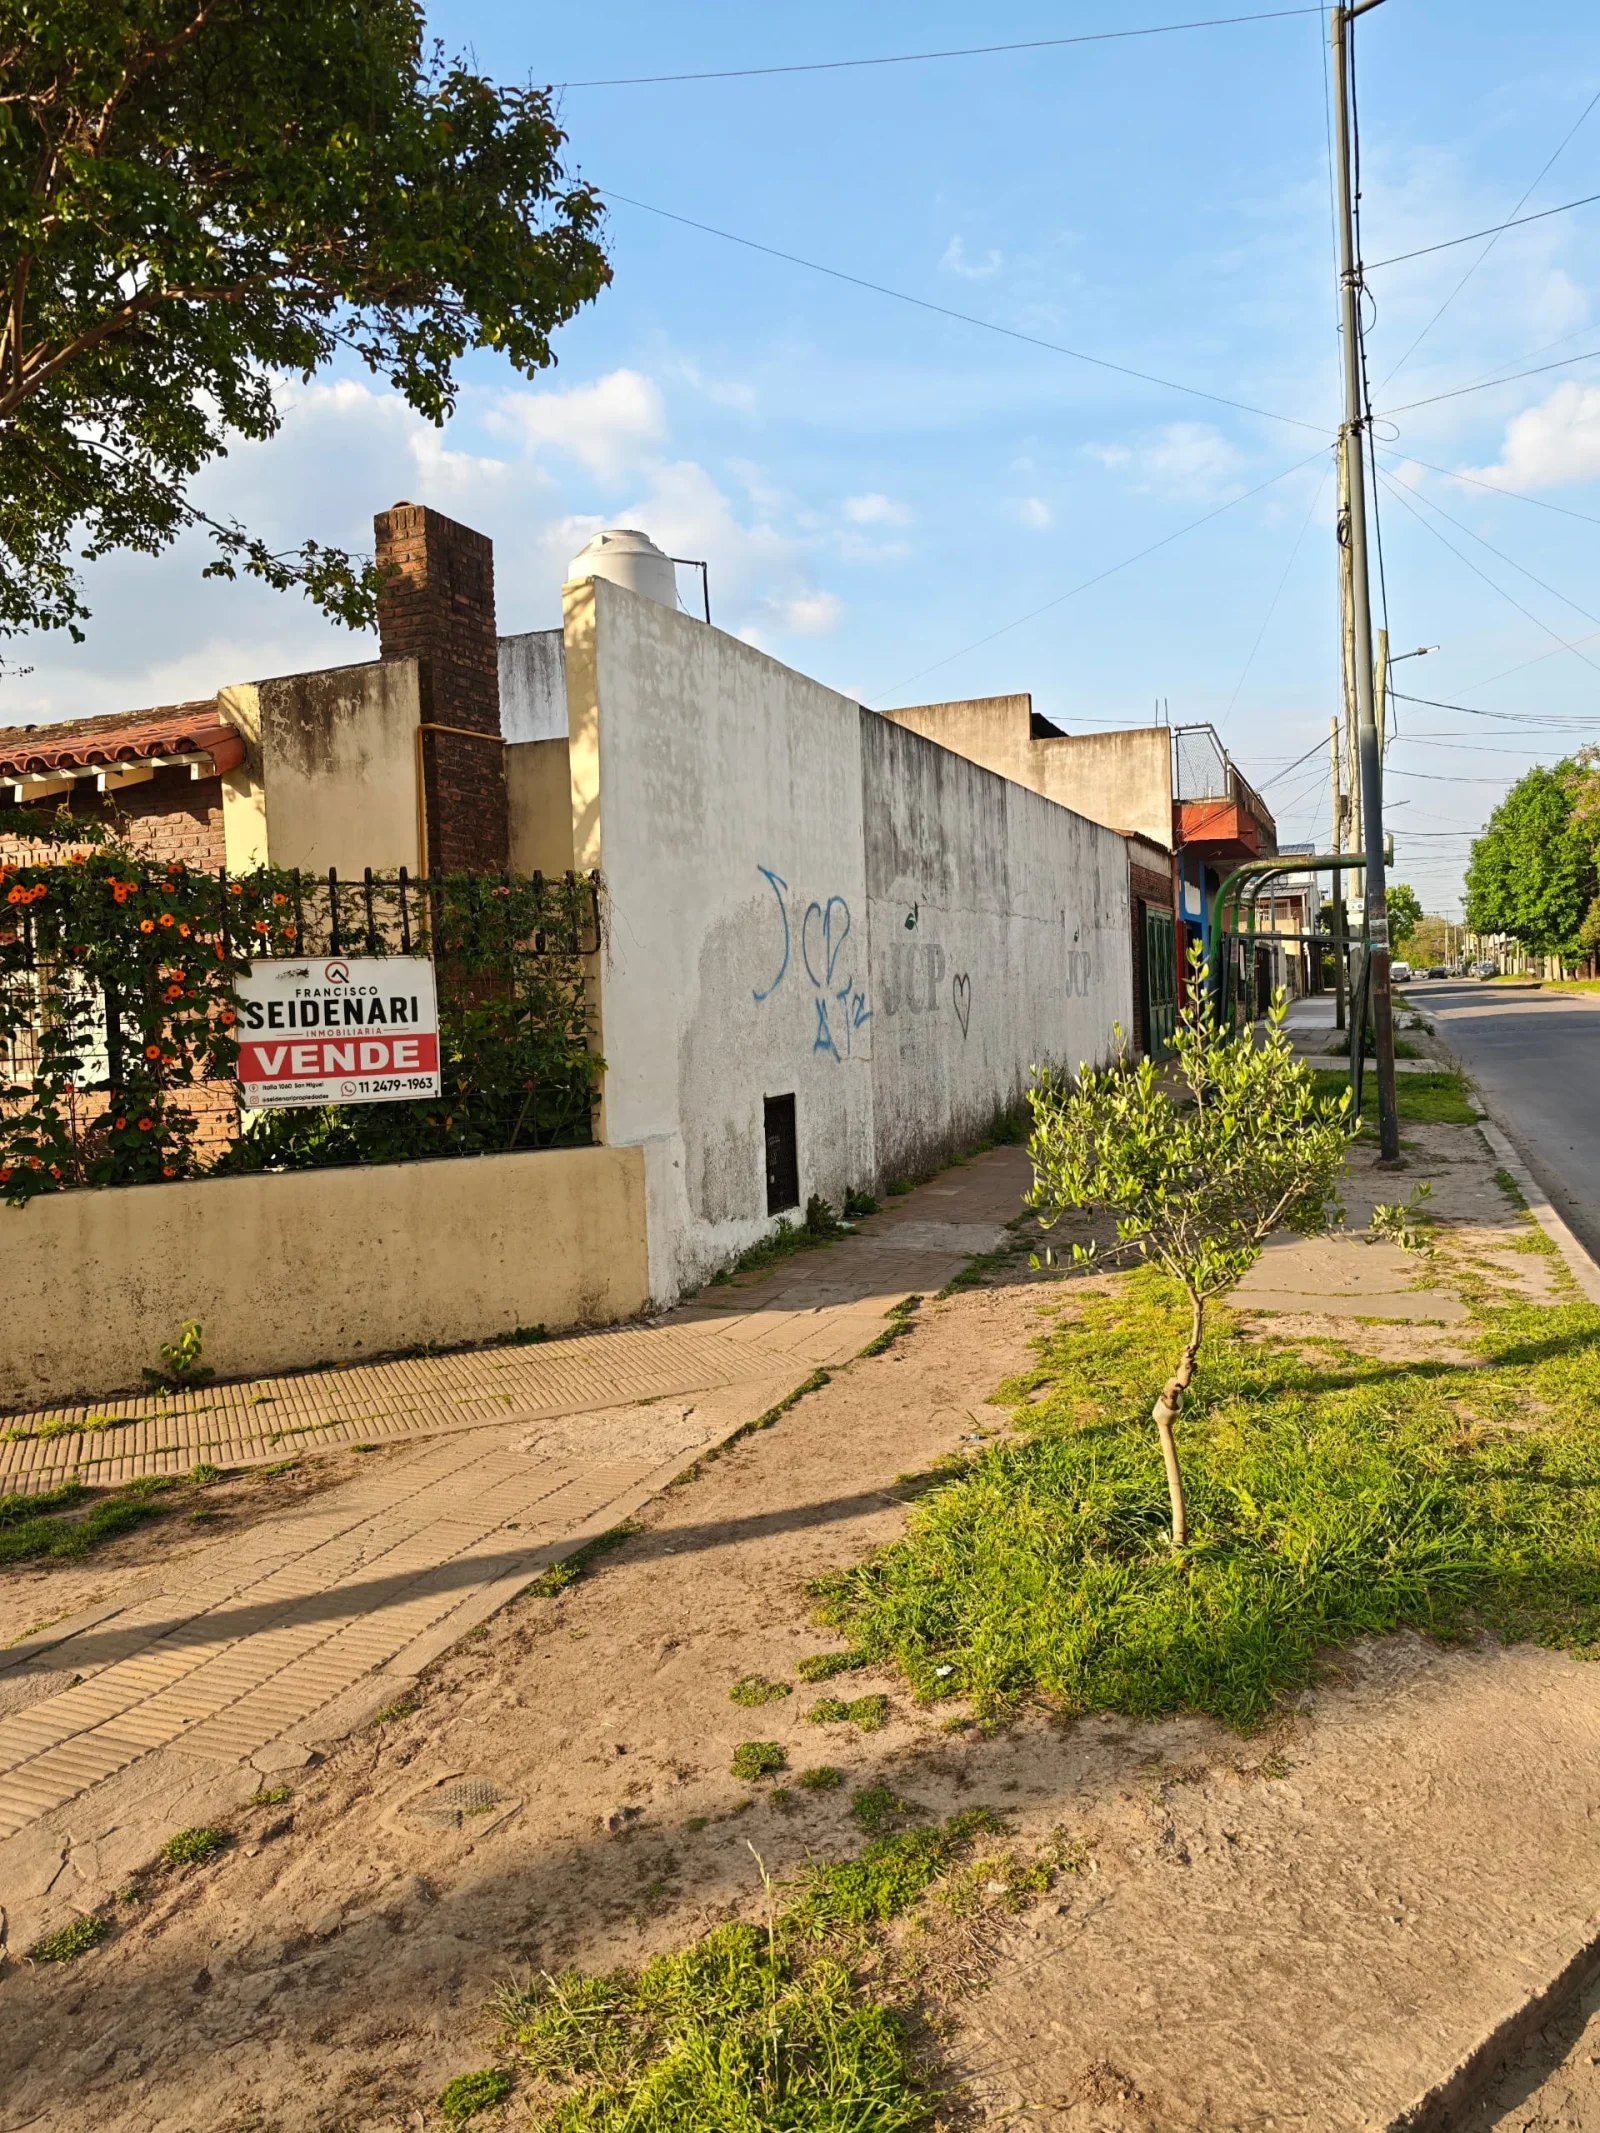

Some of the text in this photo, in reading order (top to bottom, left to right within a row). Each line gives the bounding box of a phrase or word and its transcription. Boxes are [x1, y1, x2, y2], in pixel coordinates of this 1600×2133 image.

[295, 986, 378, 998] FRANCISCO
[246, 996, 418, 1029] SEIDENARI
[305, 1027, 382, 1037] INMOBILIARIA
[253, 1040, 419, 1076] VENDE
[358, 1077, 433, 1093] 11 2479-1963
